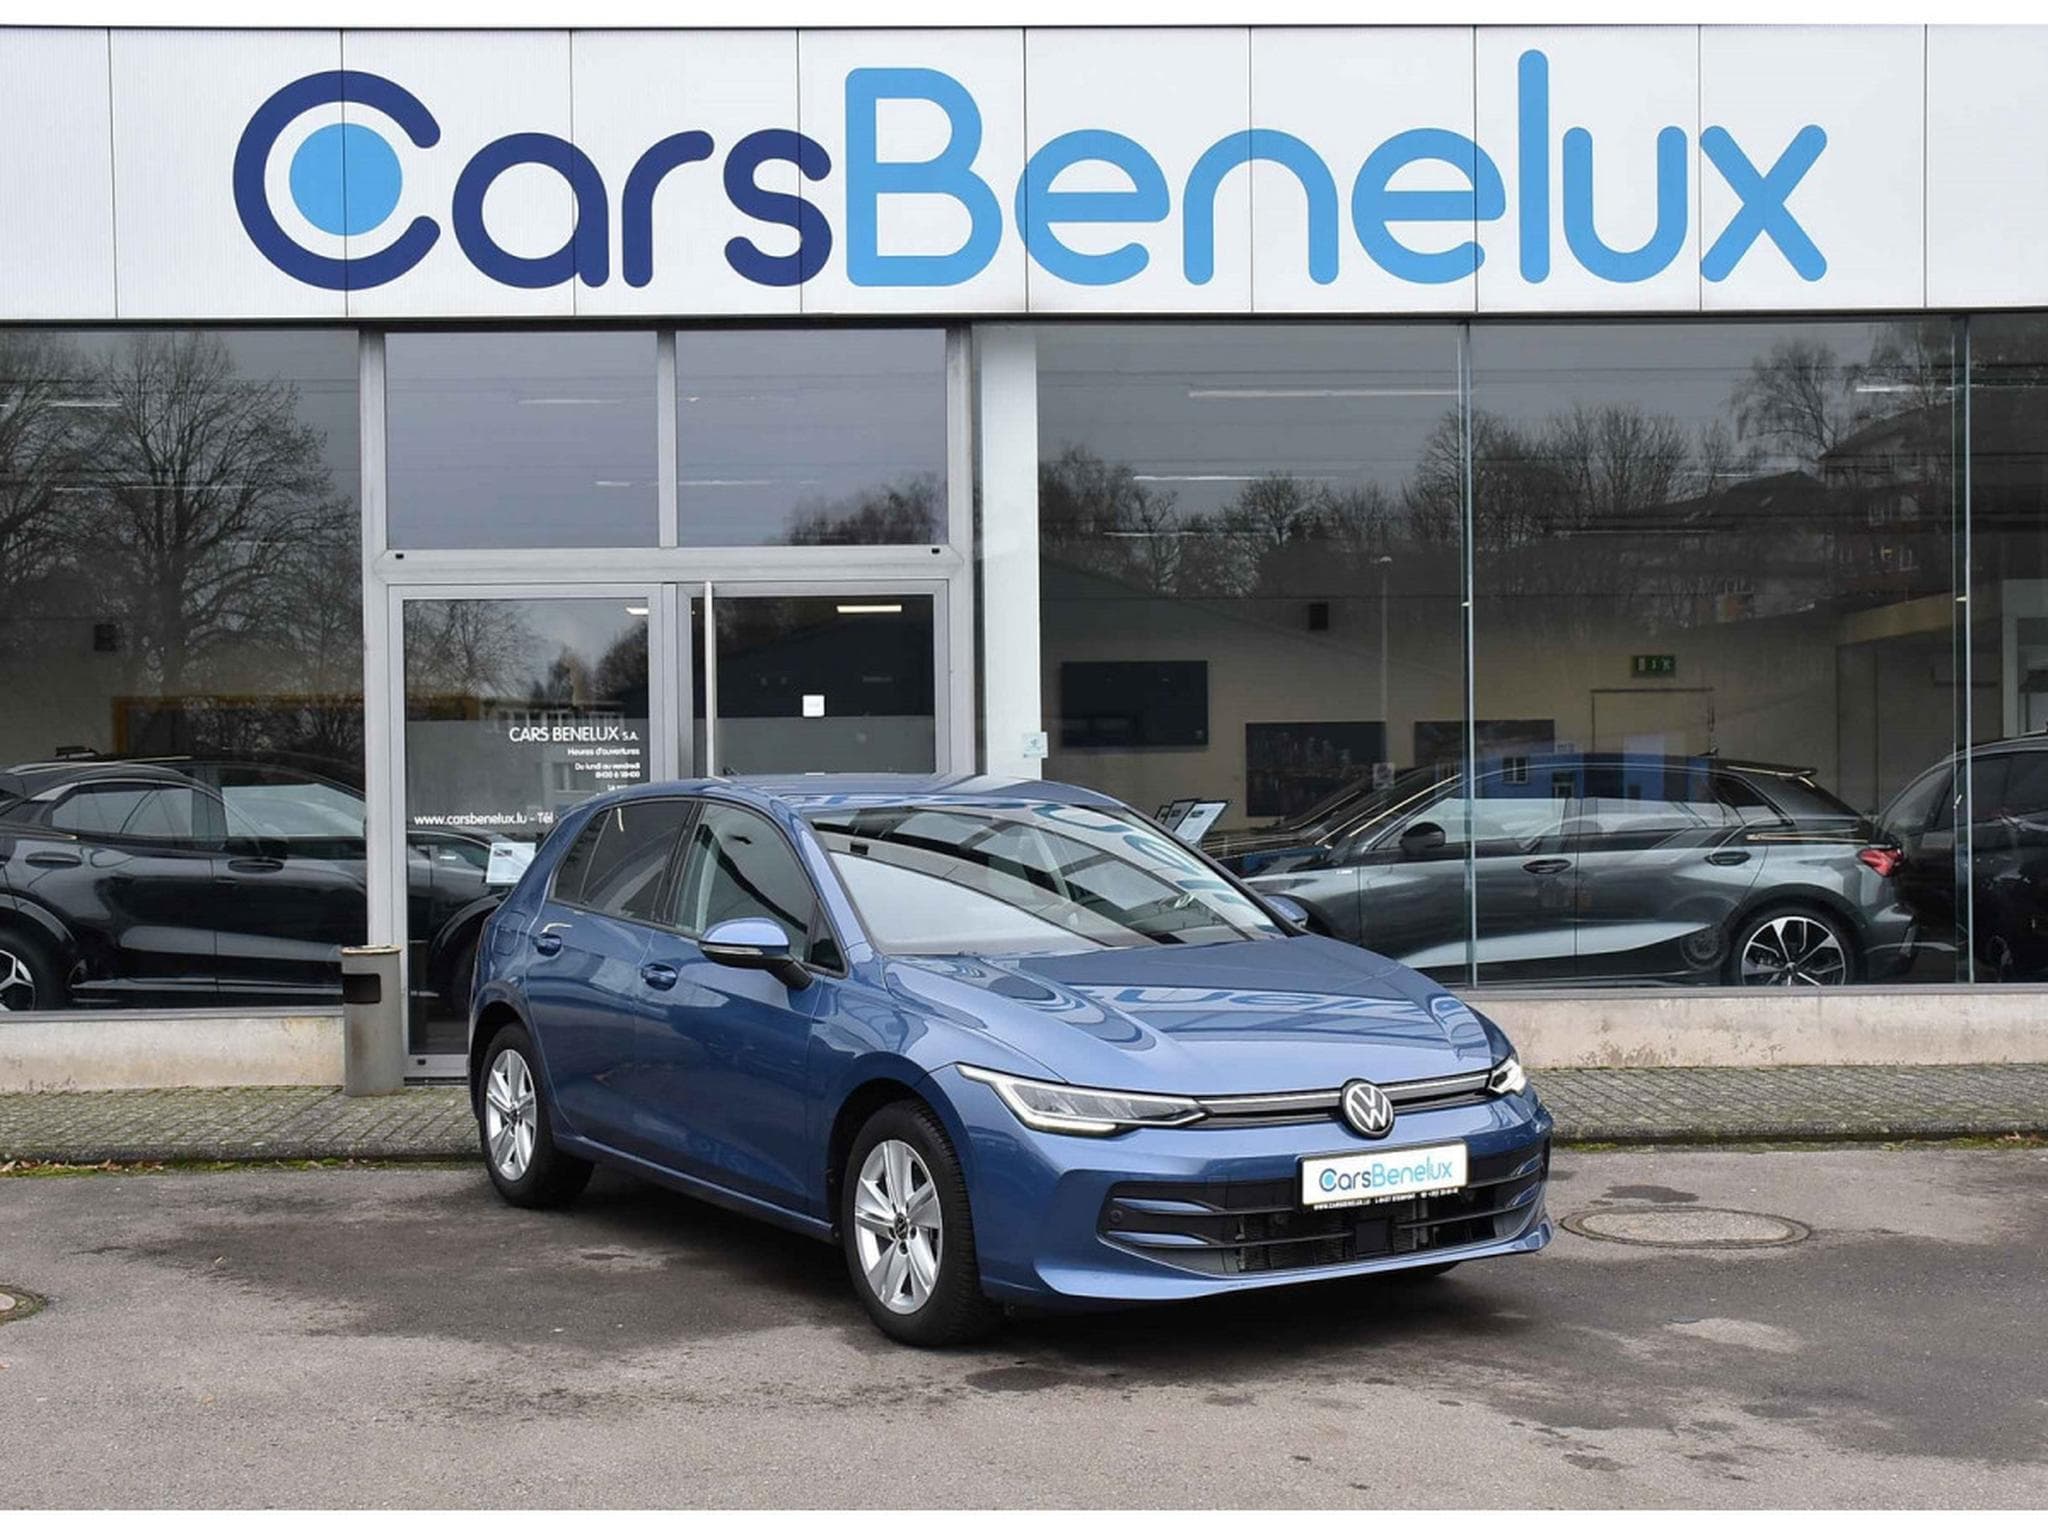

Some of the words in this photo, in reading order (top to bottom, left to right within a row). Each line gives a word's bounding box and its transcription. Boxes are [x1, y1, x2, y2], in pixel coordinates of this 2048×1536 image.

[232, 50, 1828, 291] CarsBenelux
[509, 727, 548, 742] CARS
[552, 726, 620, 741] BENELUX
[567, 747, 594, 756] Heures
[585, 762, 601, 770] lundi
[612, 762, 641, 770] vendredi
[414, 812, 527, 825] www.carsbenelux.lu
[1318, 1156, 1453, 1192] CarsBenelux
